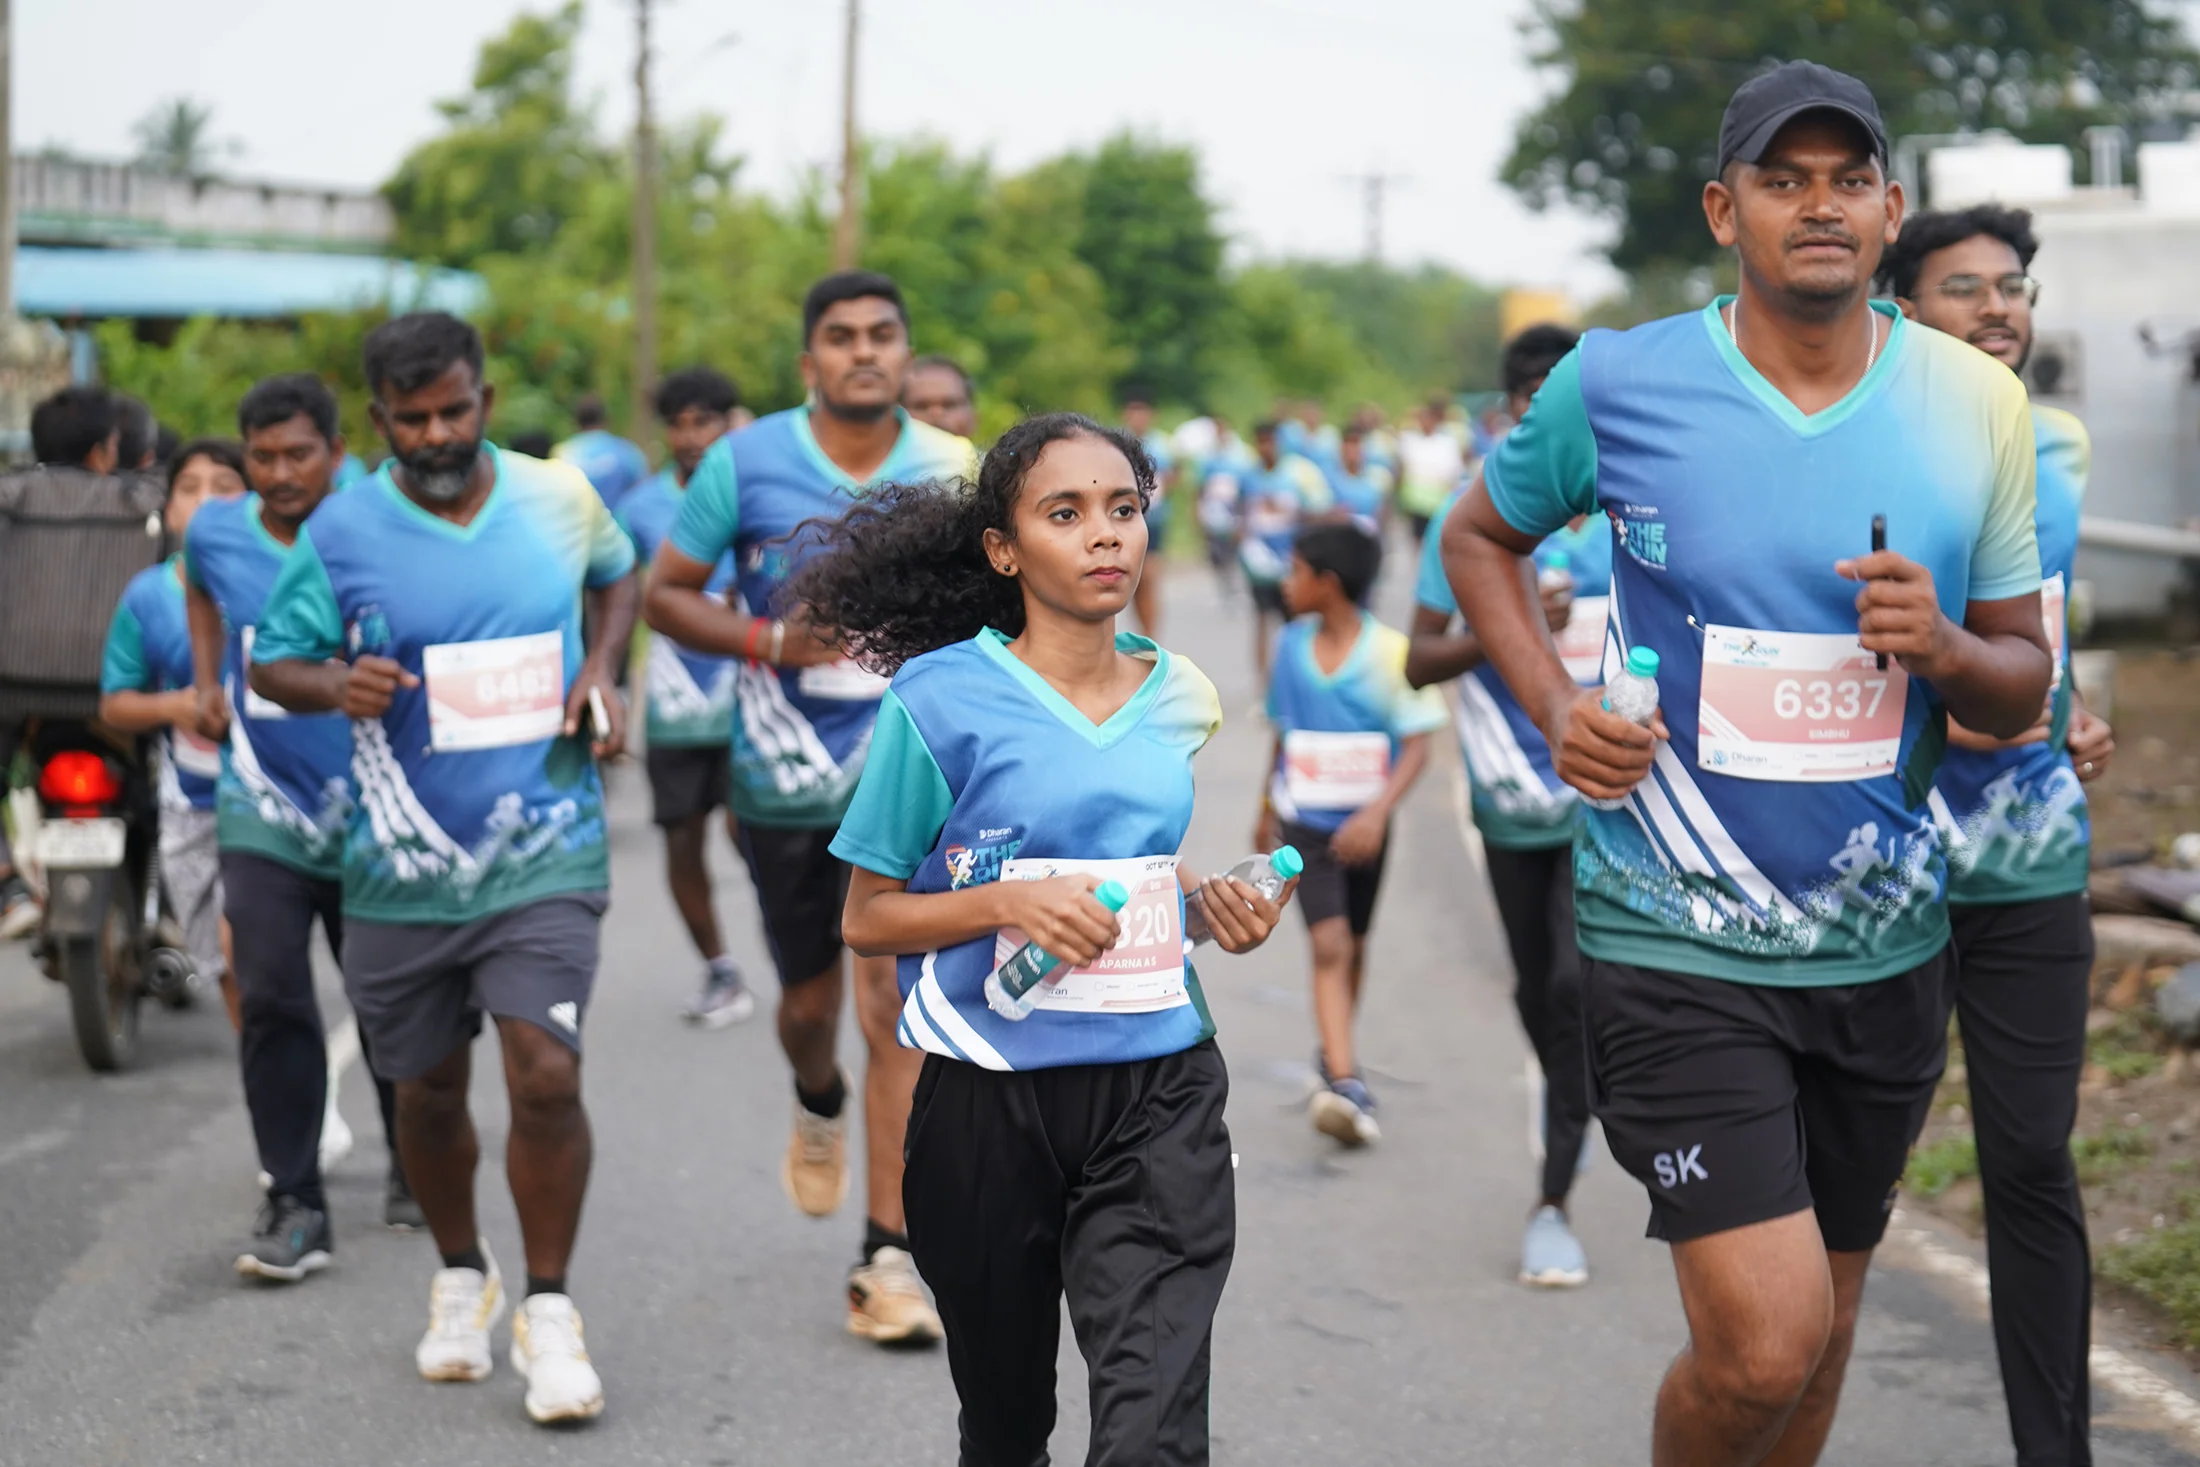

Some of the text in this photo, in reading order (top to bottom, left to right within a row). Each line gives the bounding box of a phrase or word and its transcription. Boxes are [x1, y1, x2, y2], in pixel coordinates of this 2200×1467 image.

[1625, 520, 1666, 543] THE
[1773, 678, 1887, 721] 6337
[1732, 751, 1768, 763] Dharan
[987, 827, 1013, 838] Dharan
[1116, 902, 1170, 949] 320
[1099, 956, 1157, 969] APARNA A S
[1654, 1143, 1709, 1189] SK
